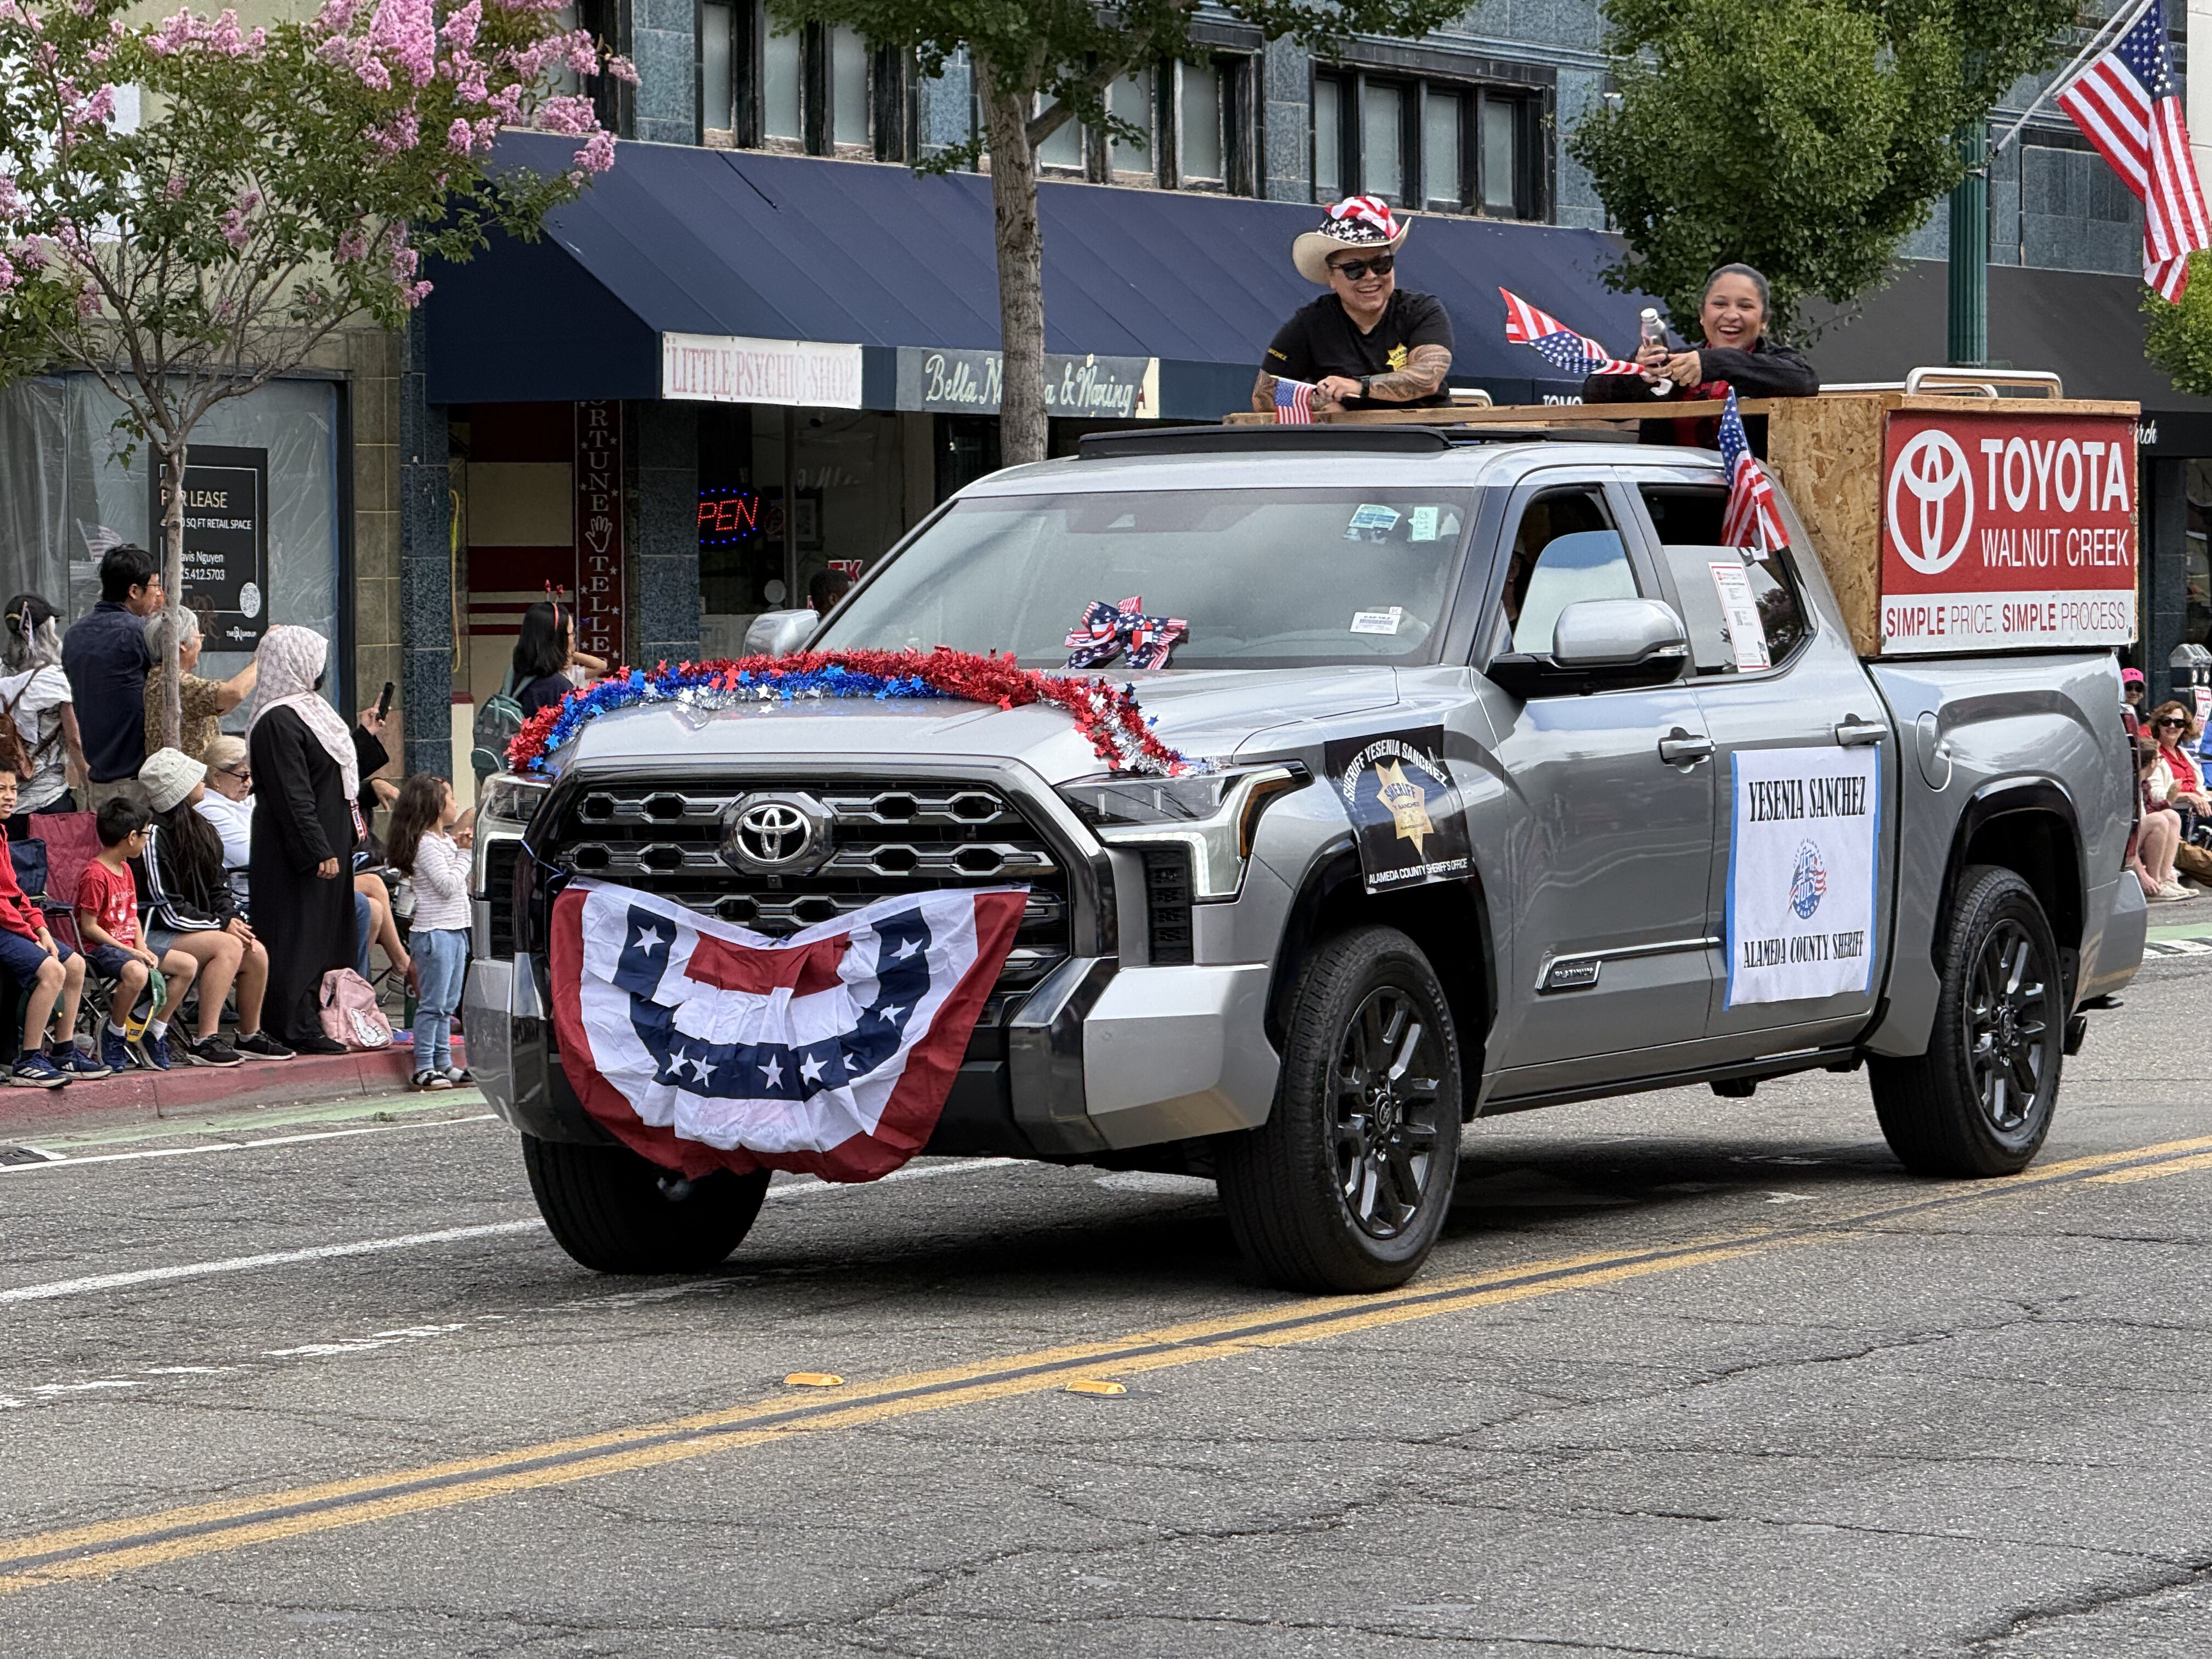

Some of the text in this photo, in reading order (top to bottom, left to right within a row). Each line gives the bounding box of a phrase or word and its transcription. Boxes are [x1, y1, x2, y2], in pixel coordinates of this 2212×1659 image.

[672, 346, 731, 395] LITTLE
[735, 351, 806, 400] PSYCHIC
[925, 354, 977, 401] Bella
[1060, 362, 1075, 405] &
[1076, 365, 1134, 417] Waxing
[2138, 419, 2157, 444] rch
[1980, 437, 2129, 512] TOYOTA
[161, 490, 228, 509] FR LEASE
[697, 496, 759, 531] PEN
[187, 518, 197, 529] SQ
[198, 518, 205, 528] FT
[207, 518, 230, 529] RETAIL
[230, 520, 252, 530] SPACE
[196, 551, 224, 565] Nguyen
[1981, 528, 2129, 567] WALNUT CREEK
[1886, 602, 2129, 637] SIMPLE PRICE. SIMPLE PROCESS.
[1343, 740, 1448, 802] SHERIFF YESENIA SANCHEZ
[1384, 782, 1416, 803] SHERIFF
[1748, 776, 1866, 822] YESENIA SANCHEZ
[1369, 857, 1468, 885] ALAMEDA COUNTY SHERIFF'S OFFICE
[1743, 930, 1864, 968] ALAMEDA COUNTY SHERIFF
